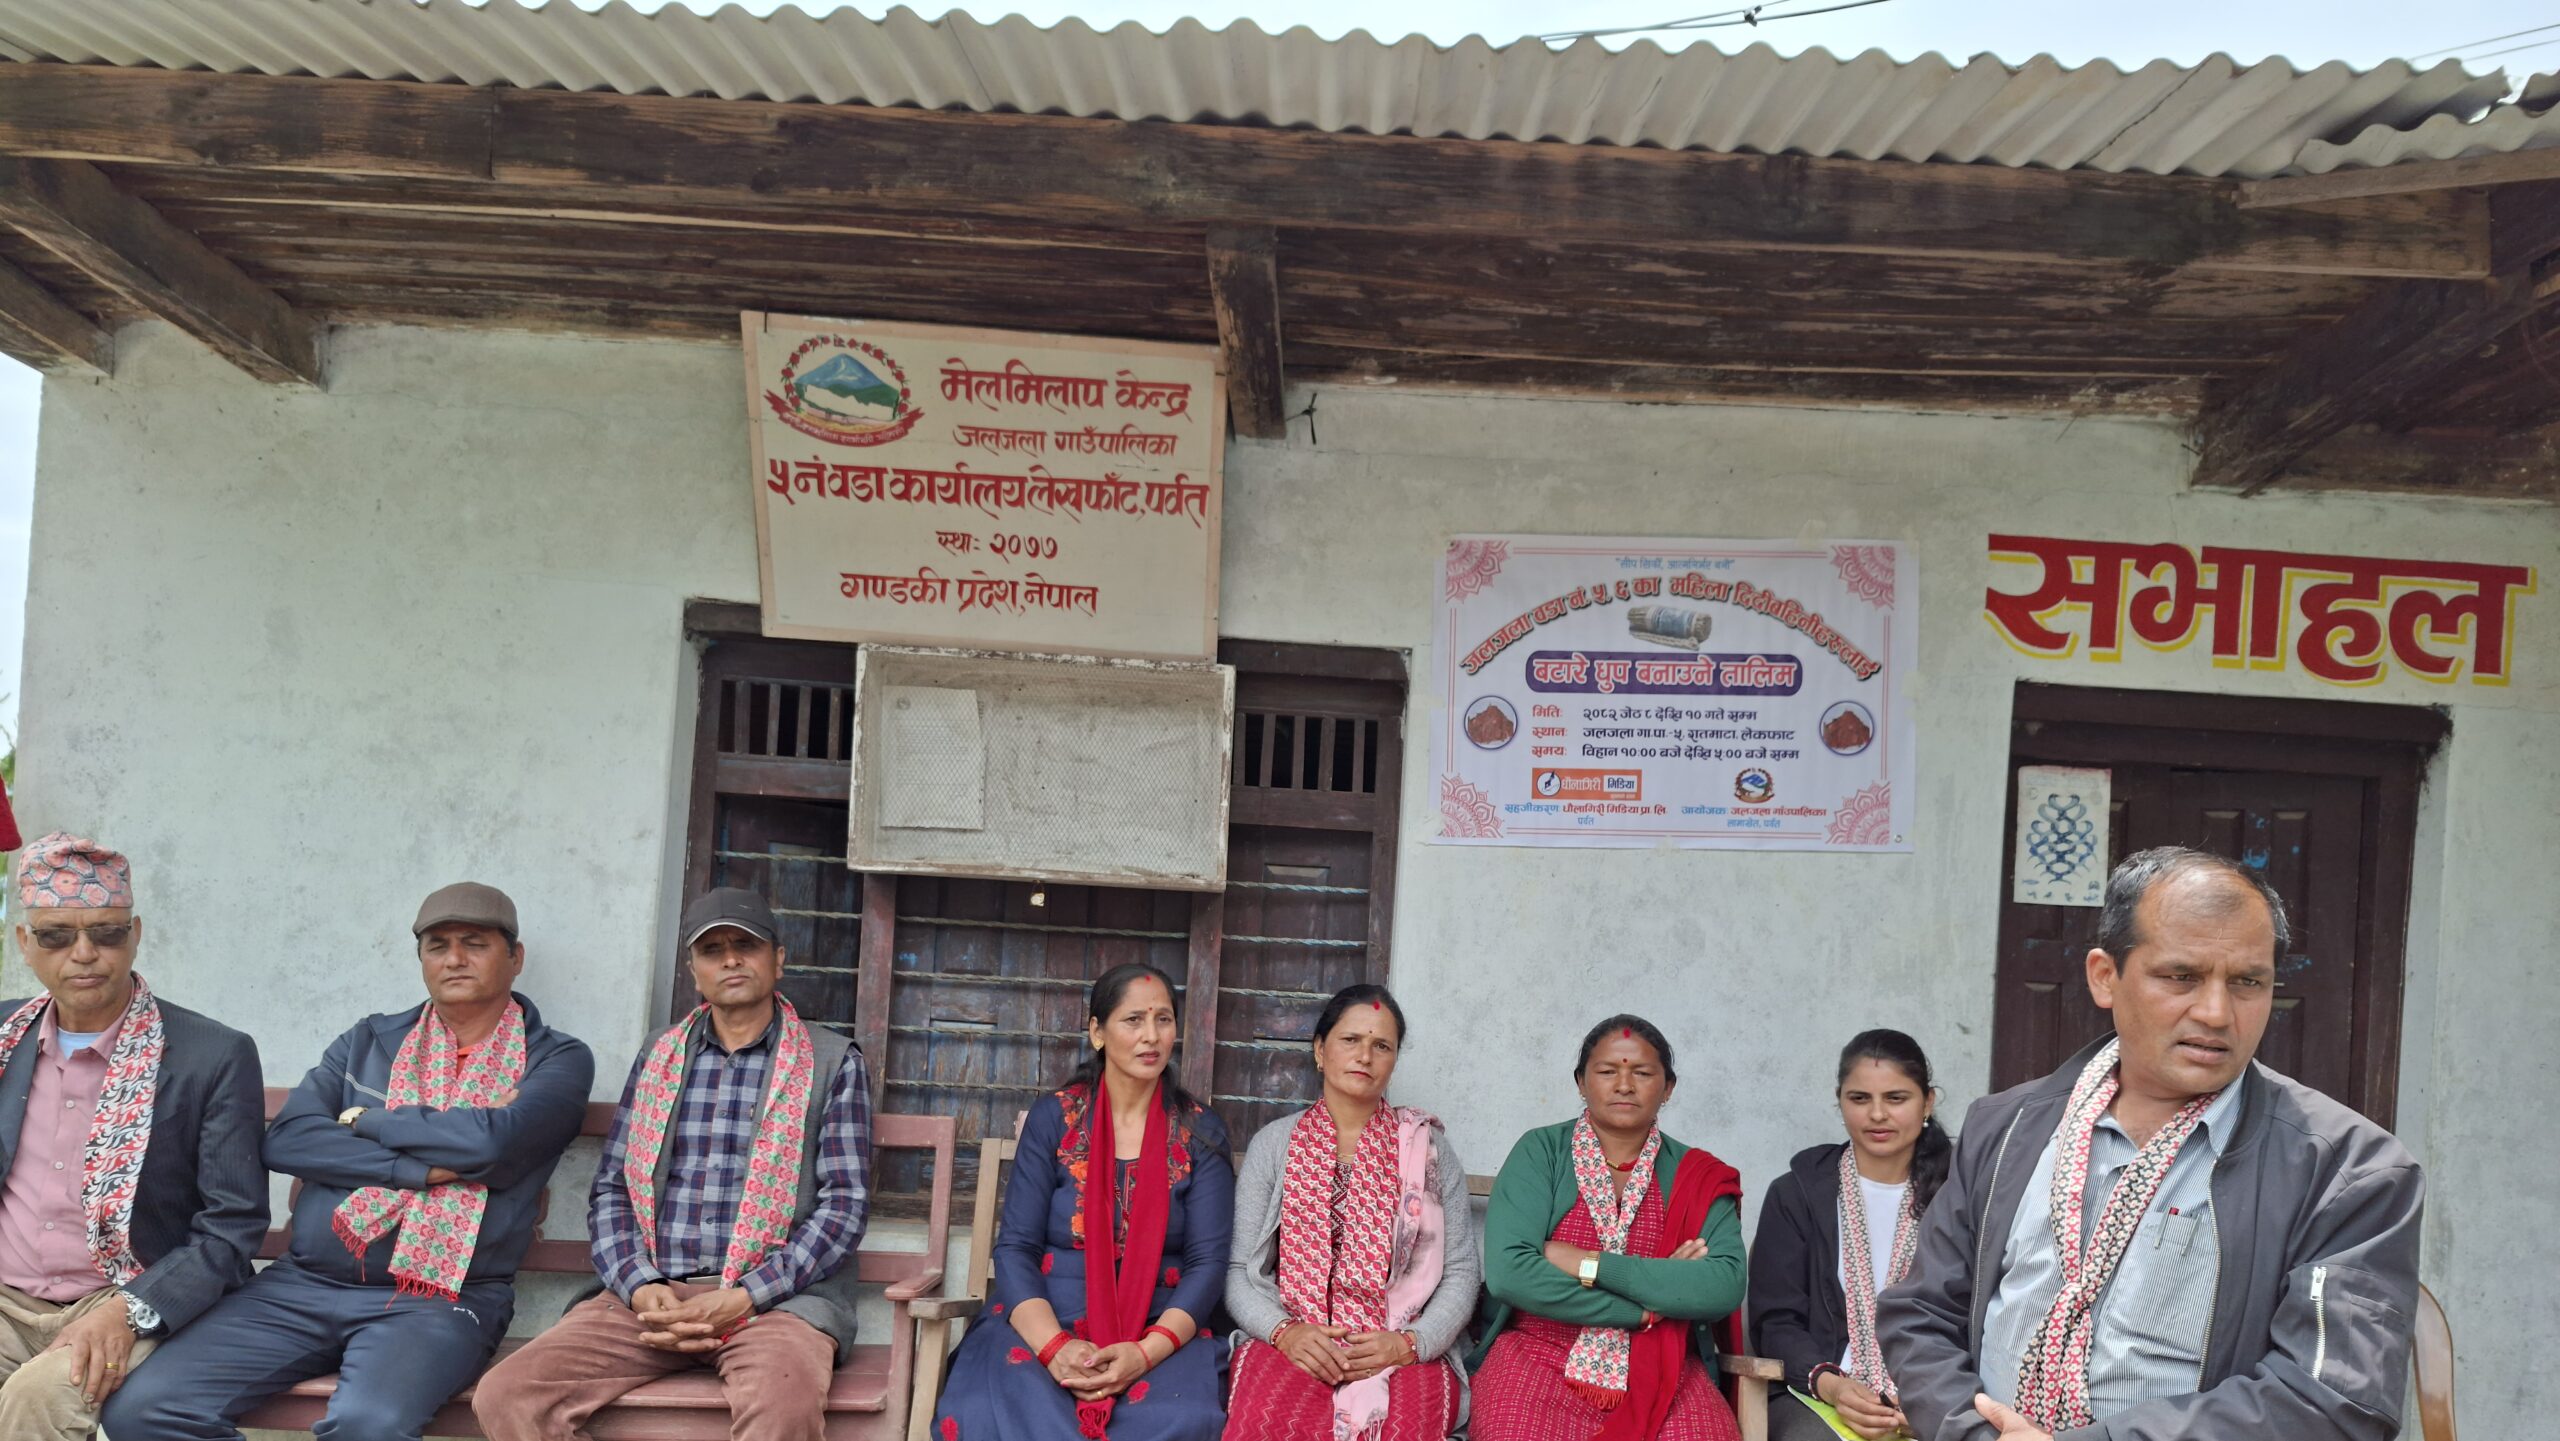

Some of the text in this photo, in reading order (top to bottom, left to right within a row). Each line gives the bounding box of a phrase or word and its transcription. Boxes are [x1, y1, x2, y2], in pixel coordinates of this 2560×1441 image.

[940, 357, 1193, 423] मेलमिलाप केन्द्र
[953, 423, 1179, 464] जलजला गाउँपालिका
[989, 532, 1058, 564] २०७७
[840, 566, 951, 605] गण्डकी
[1461, 611, 1534, 676] जलजला
[1530, 596, 1567, 625] वडा
[1632, 576, 1661, 598] का
[1669, 571, 1732, 602] महिला
[1983, 533, 2537, 688] सभाहल
[1533, 652, 1796, 693] बटारे धुप बनाउने तालिम
[1583, 708, 1618, 721] २०८२
[1620, 706, 1642, 719] जेठ
[1645, 709, 1652, 719] ८
[1654, 706, 1683, 722] देखि
[1685, 710, 1702, 720] १०
[1704, 707, 1725, 720] गते
[1727, 710, 1758, 723] सम्म
[1583, 727, 1635, 740] जलजला
[1741, 727, 1796, 741] लेकफाट
[1684, 745, 1712, 761] देखि
[1769, 749, 1800, 761] सम्म
[1607, 777, 1635, 789] मिडिया
[1730, 806, 1771, 817] जलजला
